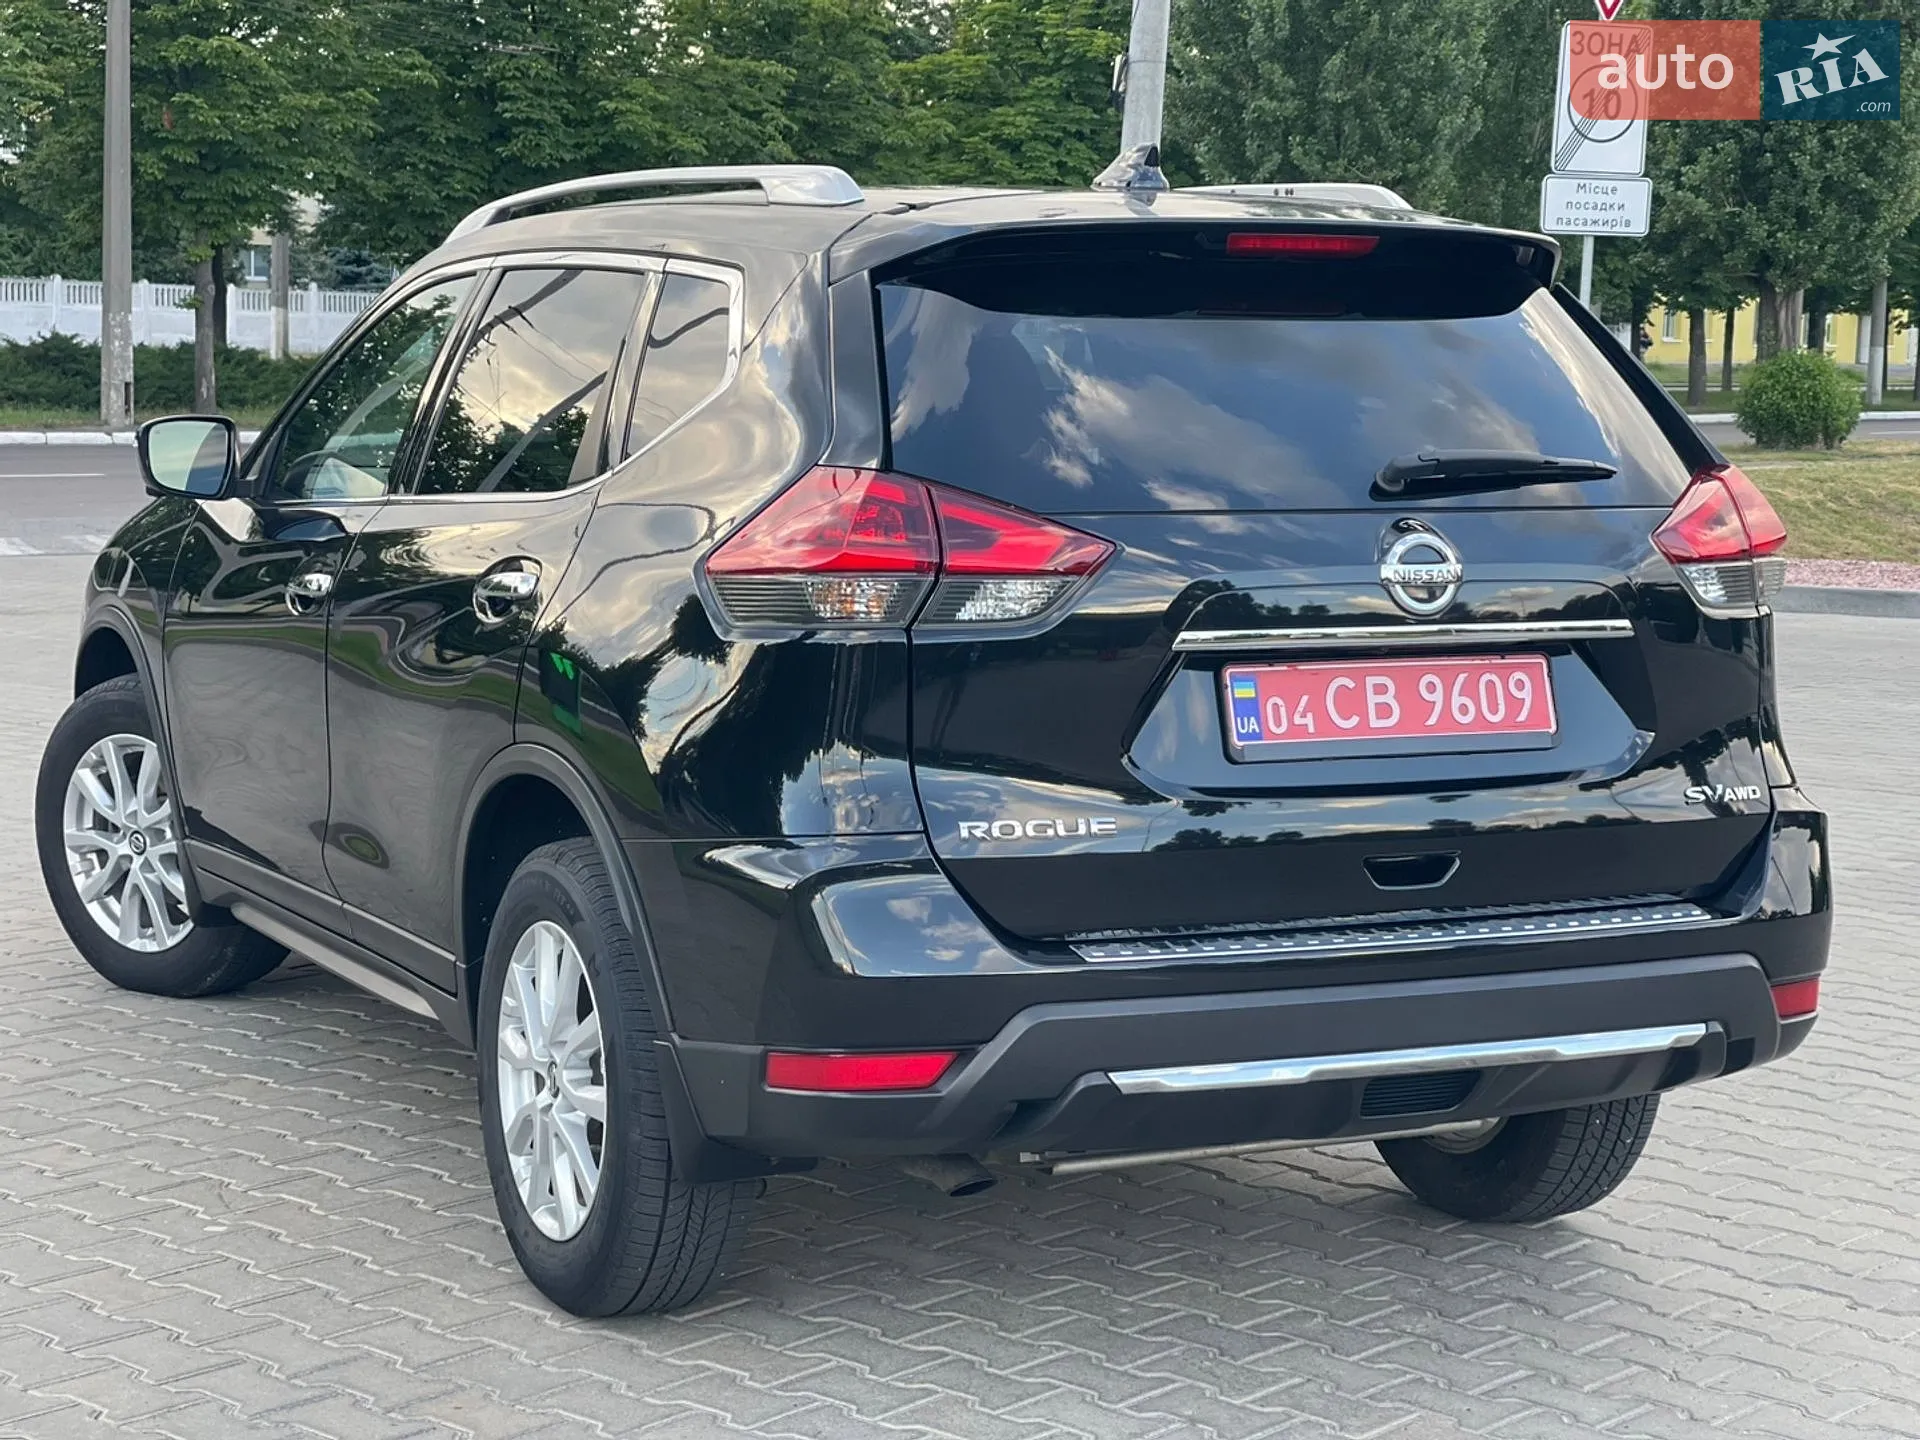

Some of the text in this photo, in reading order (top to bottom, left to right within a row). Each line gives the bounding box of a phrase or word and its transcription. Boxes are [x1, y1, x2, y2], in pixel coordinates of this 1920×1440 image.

[1570, 30, 1641, 57] ЗОНА
[1582, 87, 1622, 120] 10
[1576, 182, 1618, 195] Місце
[1566, 201, 1626, 212] посадки
[1556, 215, 1632, 230] пасажирів
[1393, 568, 1458, 581] NISSAN
[1418, 670, 1533, 726] 9609
[1237, 716, 1260, 734] UA
[958, 817, 1118, 842] ROGUE
